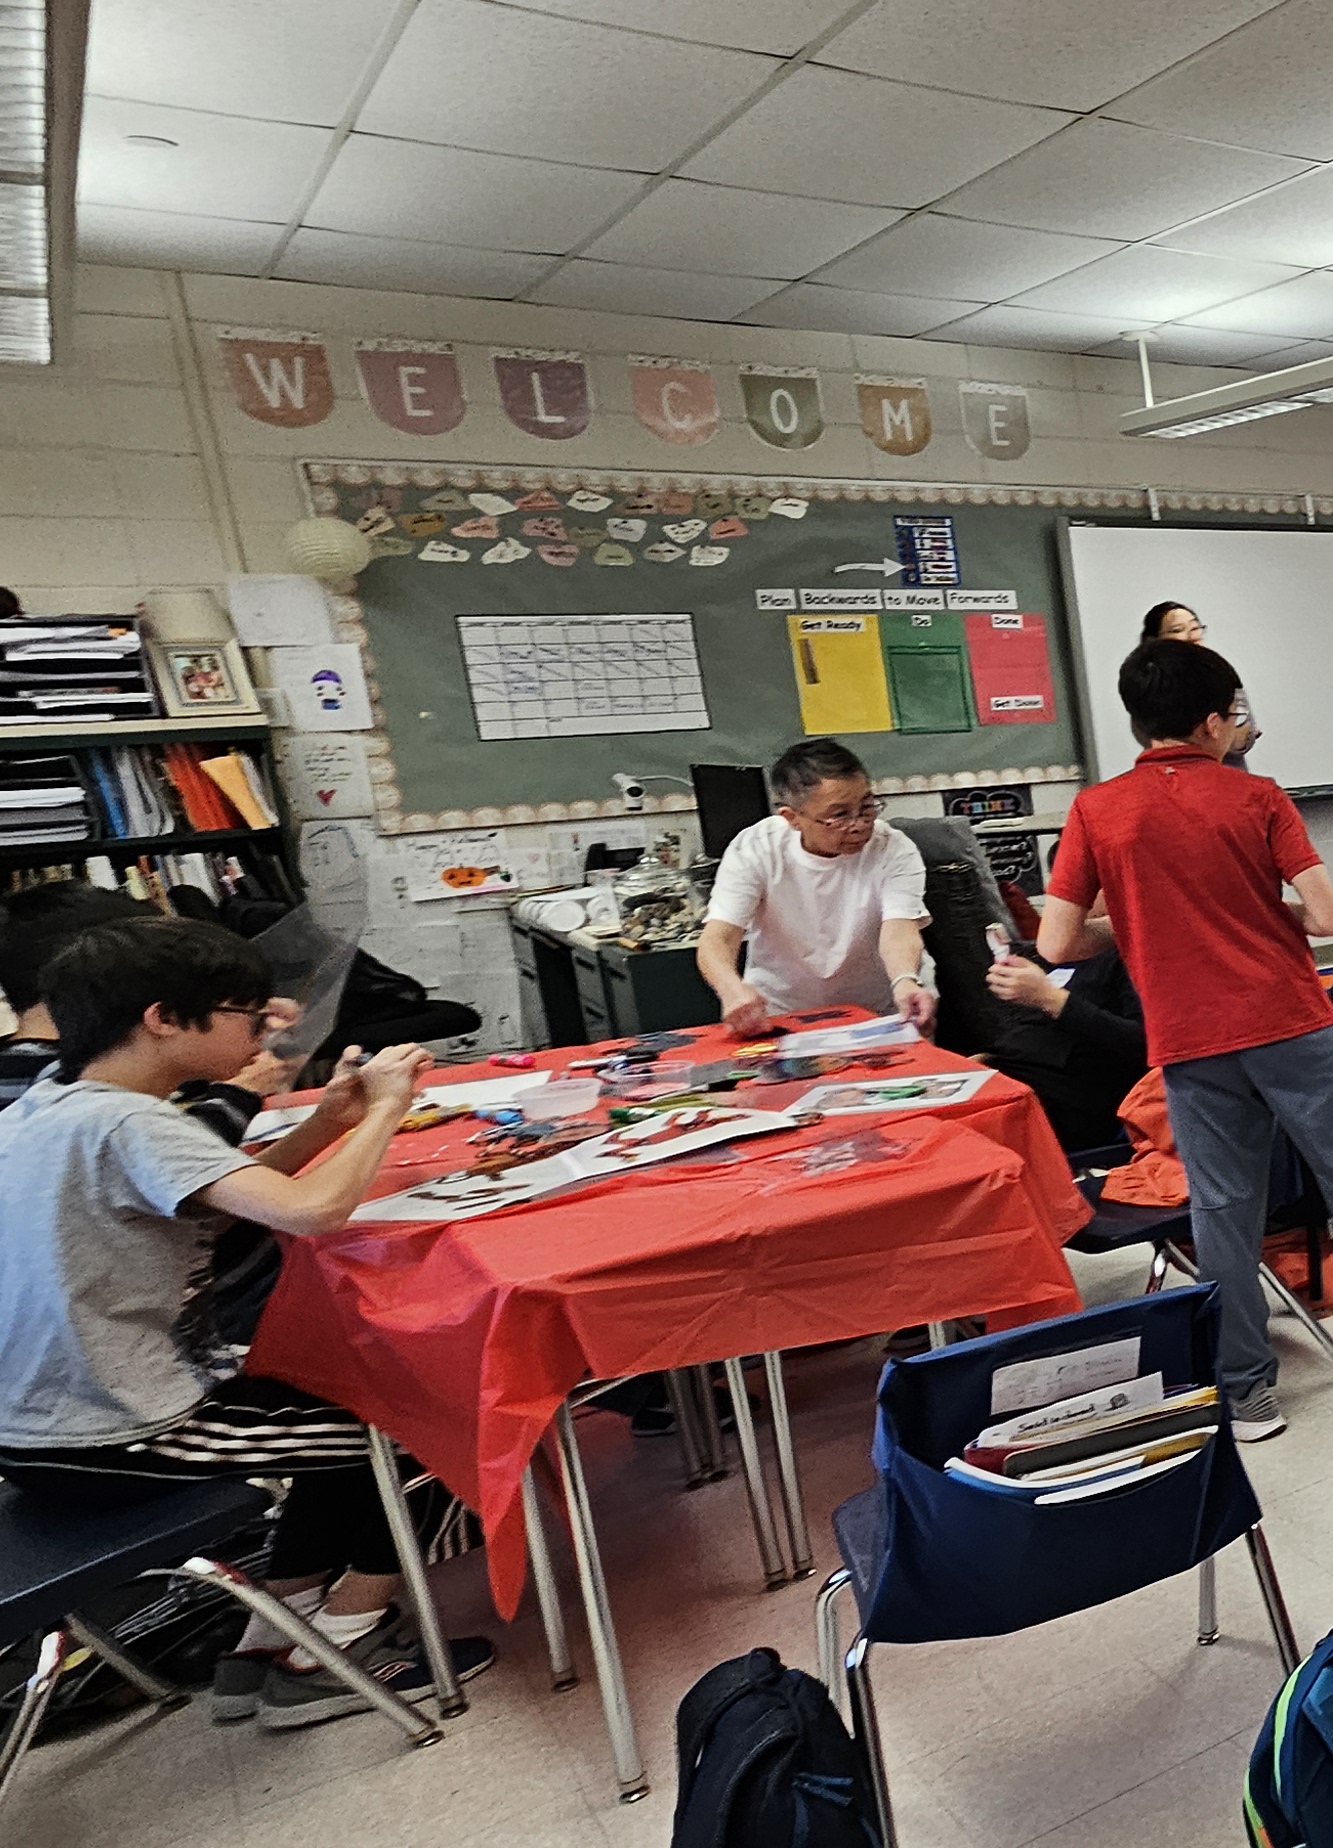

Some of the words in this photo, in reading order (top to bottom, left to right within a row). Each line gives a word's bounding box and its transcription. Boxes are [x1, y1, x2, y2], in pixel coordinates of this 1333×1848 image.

[760, 595, 792, 607] Plan
[804, 593, 878, 606] Backwards
[886, 595, 902, 606] to
[905, 594, 941, 606] Move
[949, 592, 1010, 604] Forwards
[801, 620, 821, 630] Get
[825, 620, 862, 632] Ready
[994, 616, 1020, 626] Done
